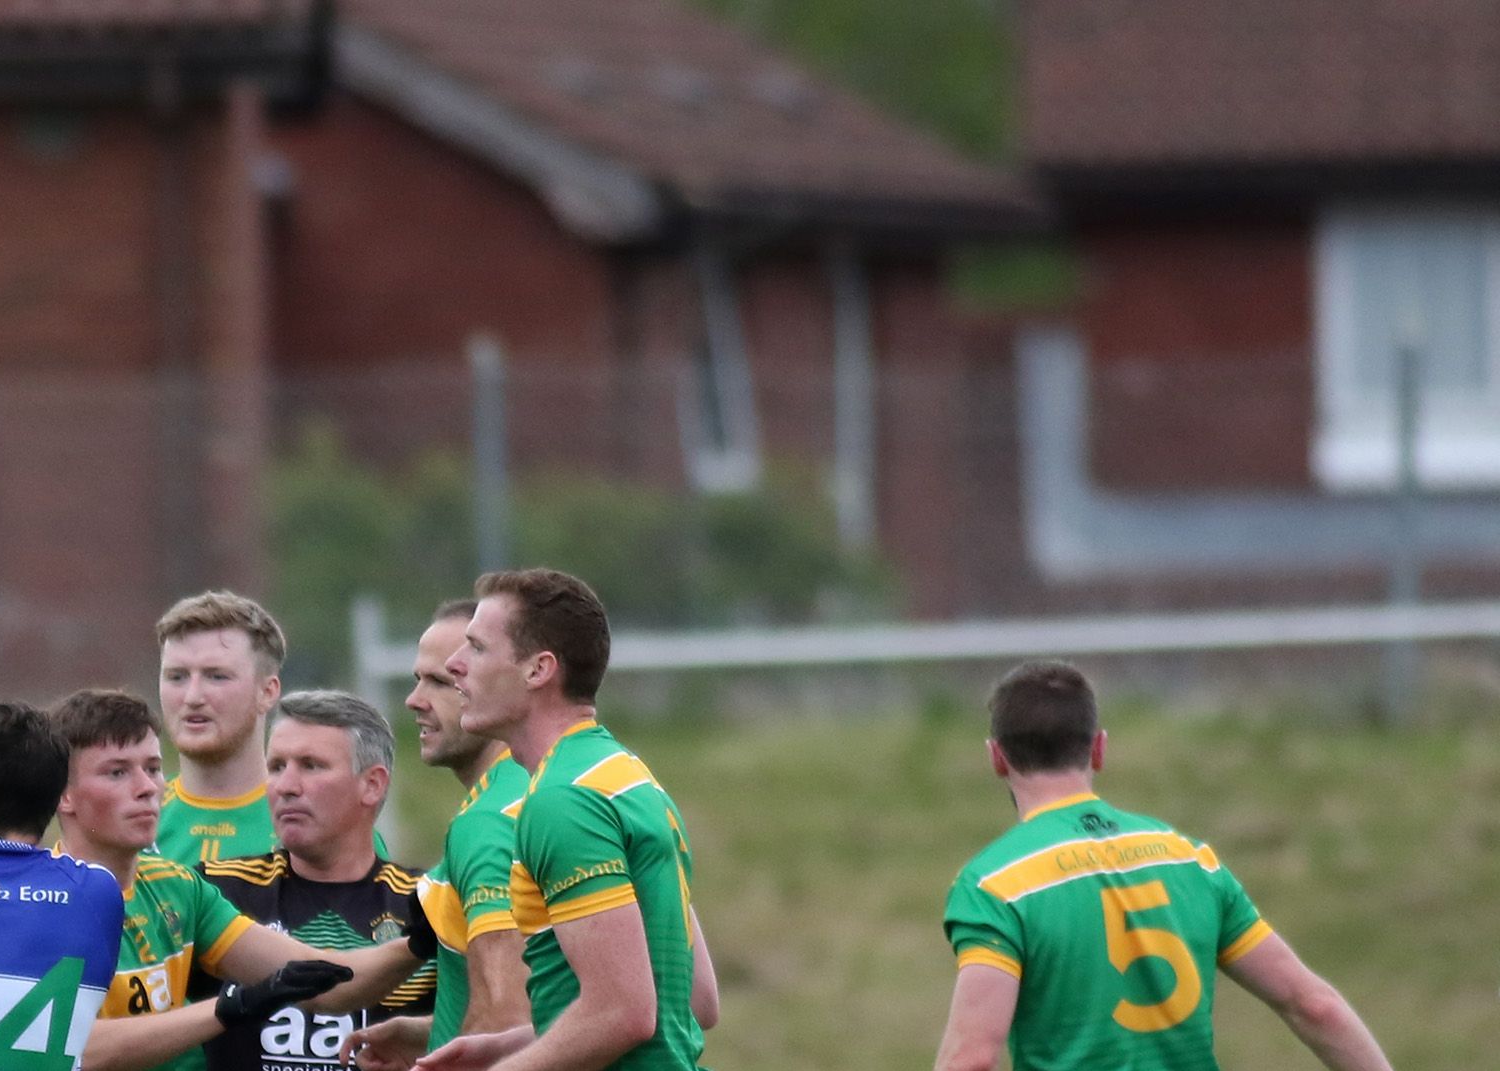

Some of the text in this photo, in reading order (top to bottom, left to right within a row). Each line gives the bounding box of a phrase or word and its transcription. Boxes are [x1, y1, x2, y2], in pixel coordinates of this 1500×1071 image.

[19, 885, 69, 904] Eoin
[1101, 879, 1202, 1033] 5
[260, 1006, 355, 1058] aa
